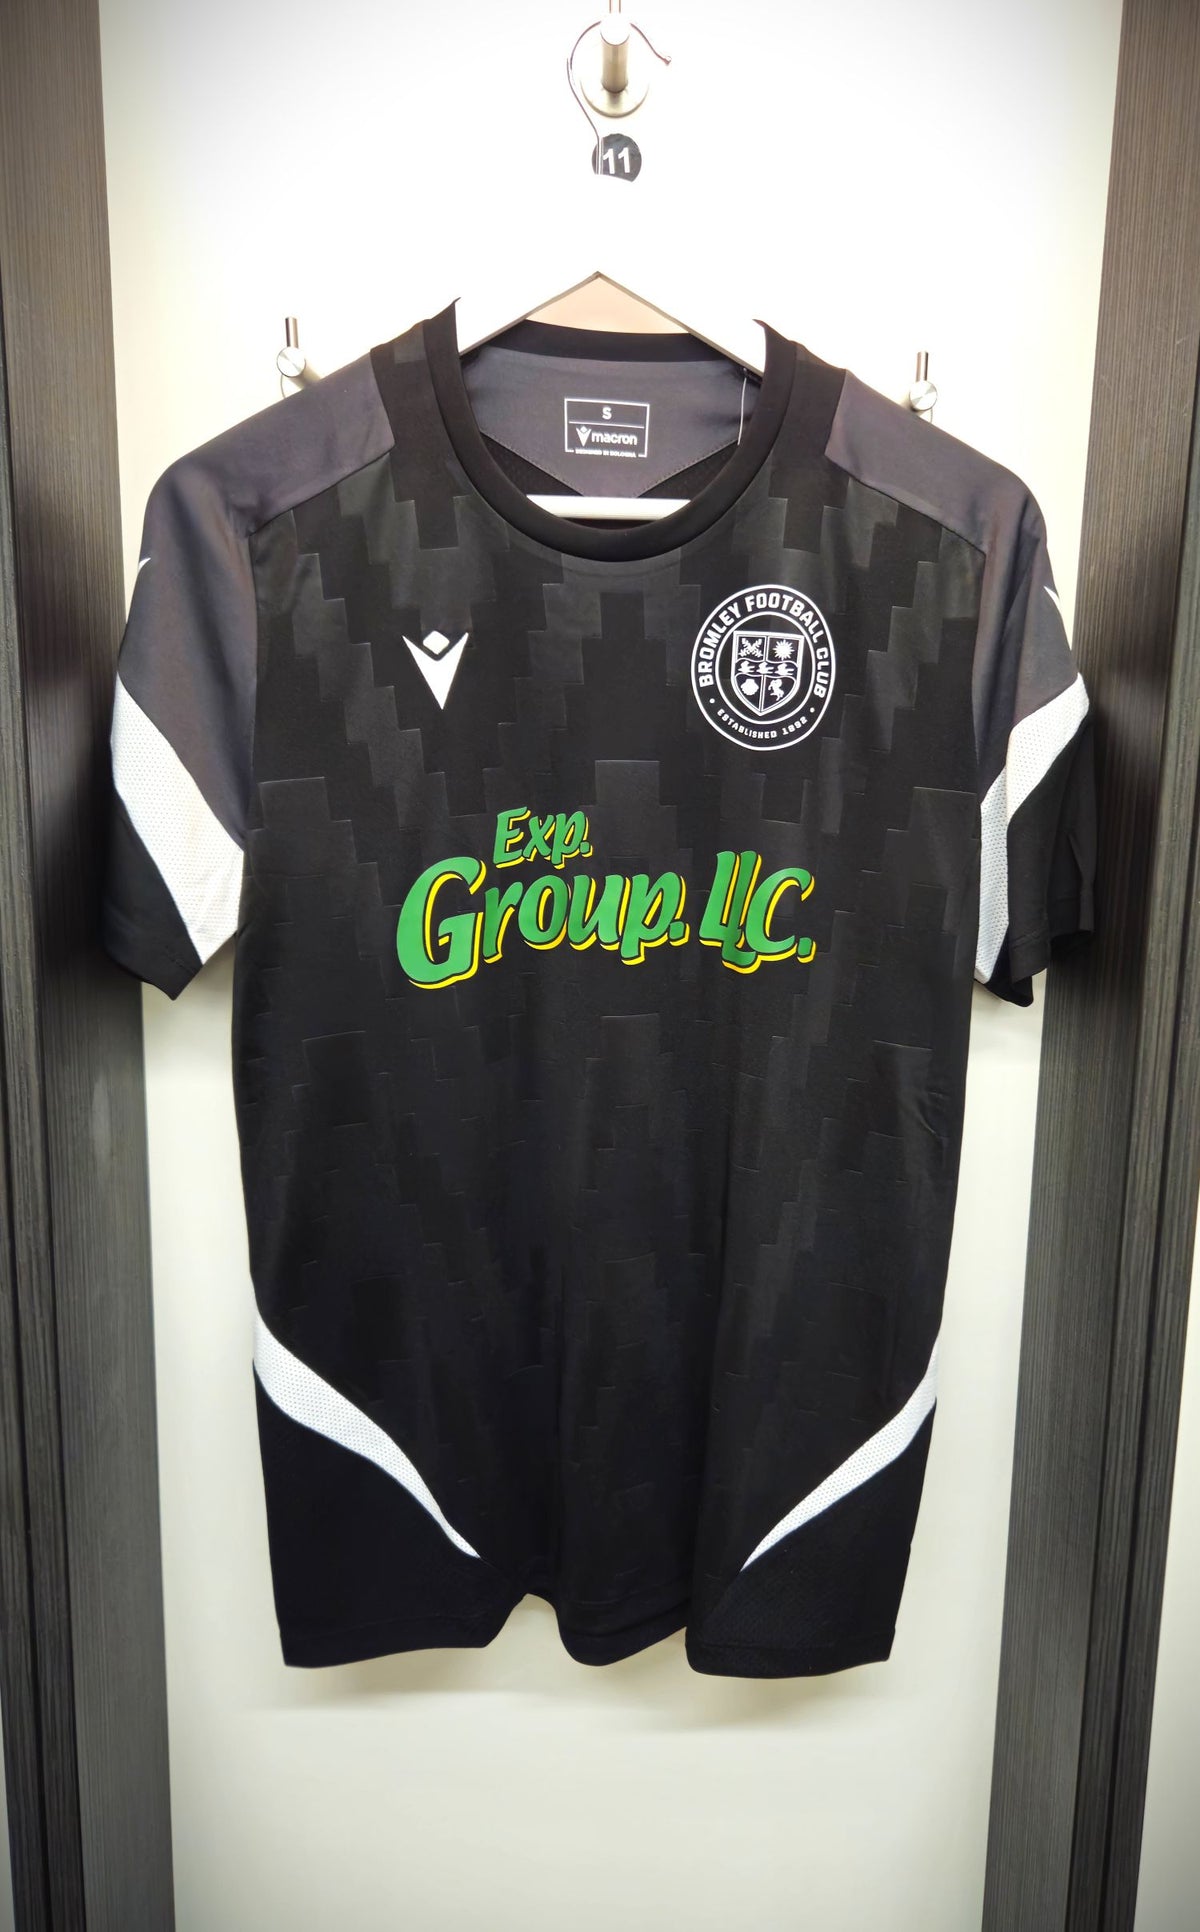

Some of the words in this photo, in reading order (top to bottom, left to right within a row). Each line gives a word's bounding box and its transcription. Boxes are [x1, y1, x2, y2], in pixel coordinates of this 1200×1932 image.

[603, 147, 630, 174] 11
[602, 406, 612, 420] S
[591, 432, 638, 446] macron
[698, 602, 742, 687] BROMLEY
[745, 593, 824, 643] FOOTBALL
[814, 647, 830, 698] CLUB
[717, 708, 777, 739] ESTABLISHED
[782, 716, 808, 736] 1892
[493, 806, 593, 869] Exp.
[396, 856, 690, 989] Group.
